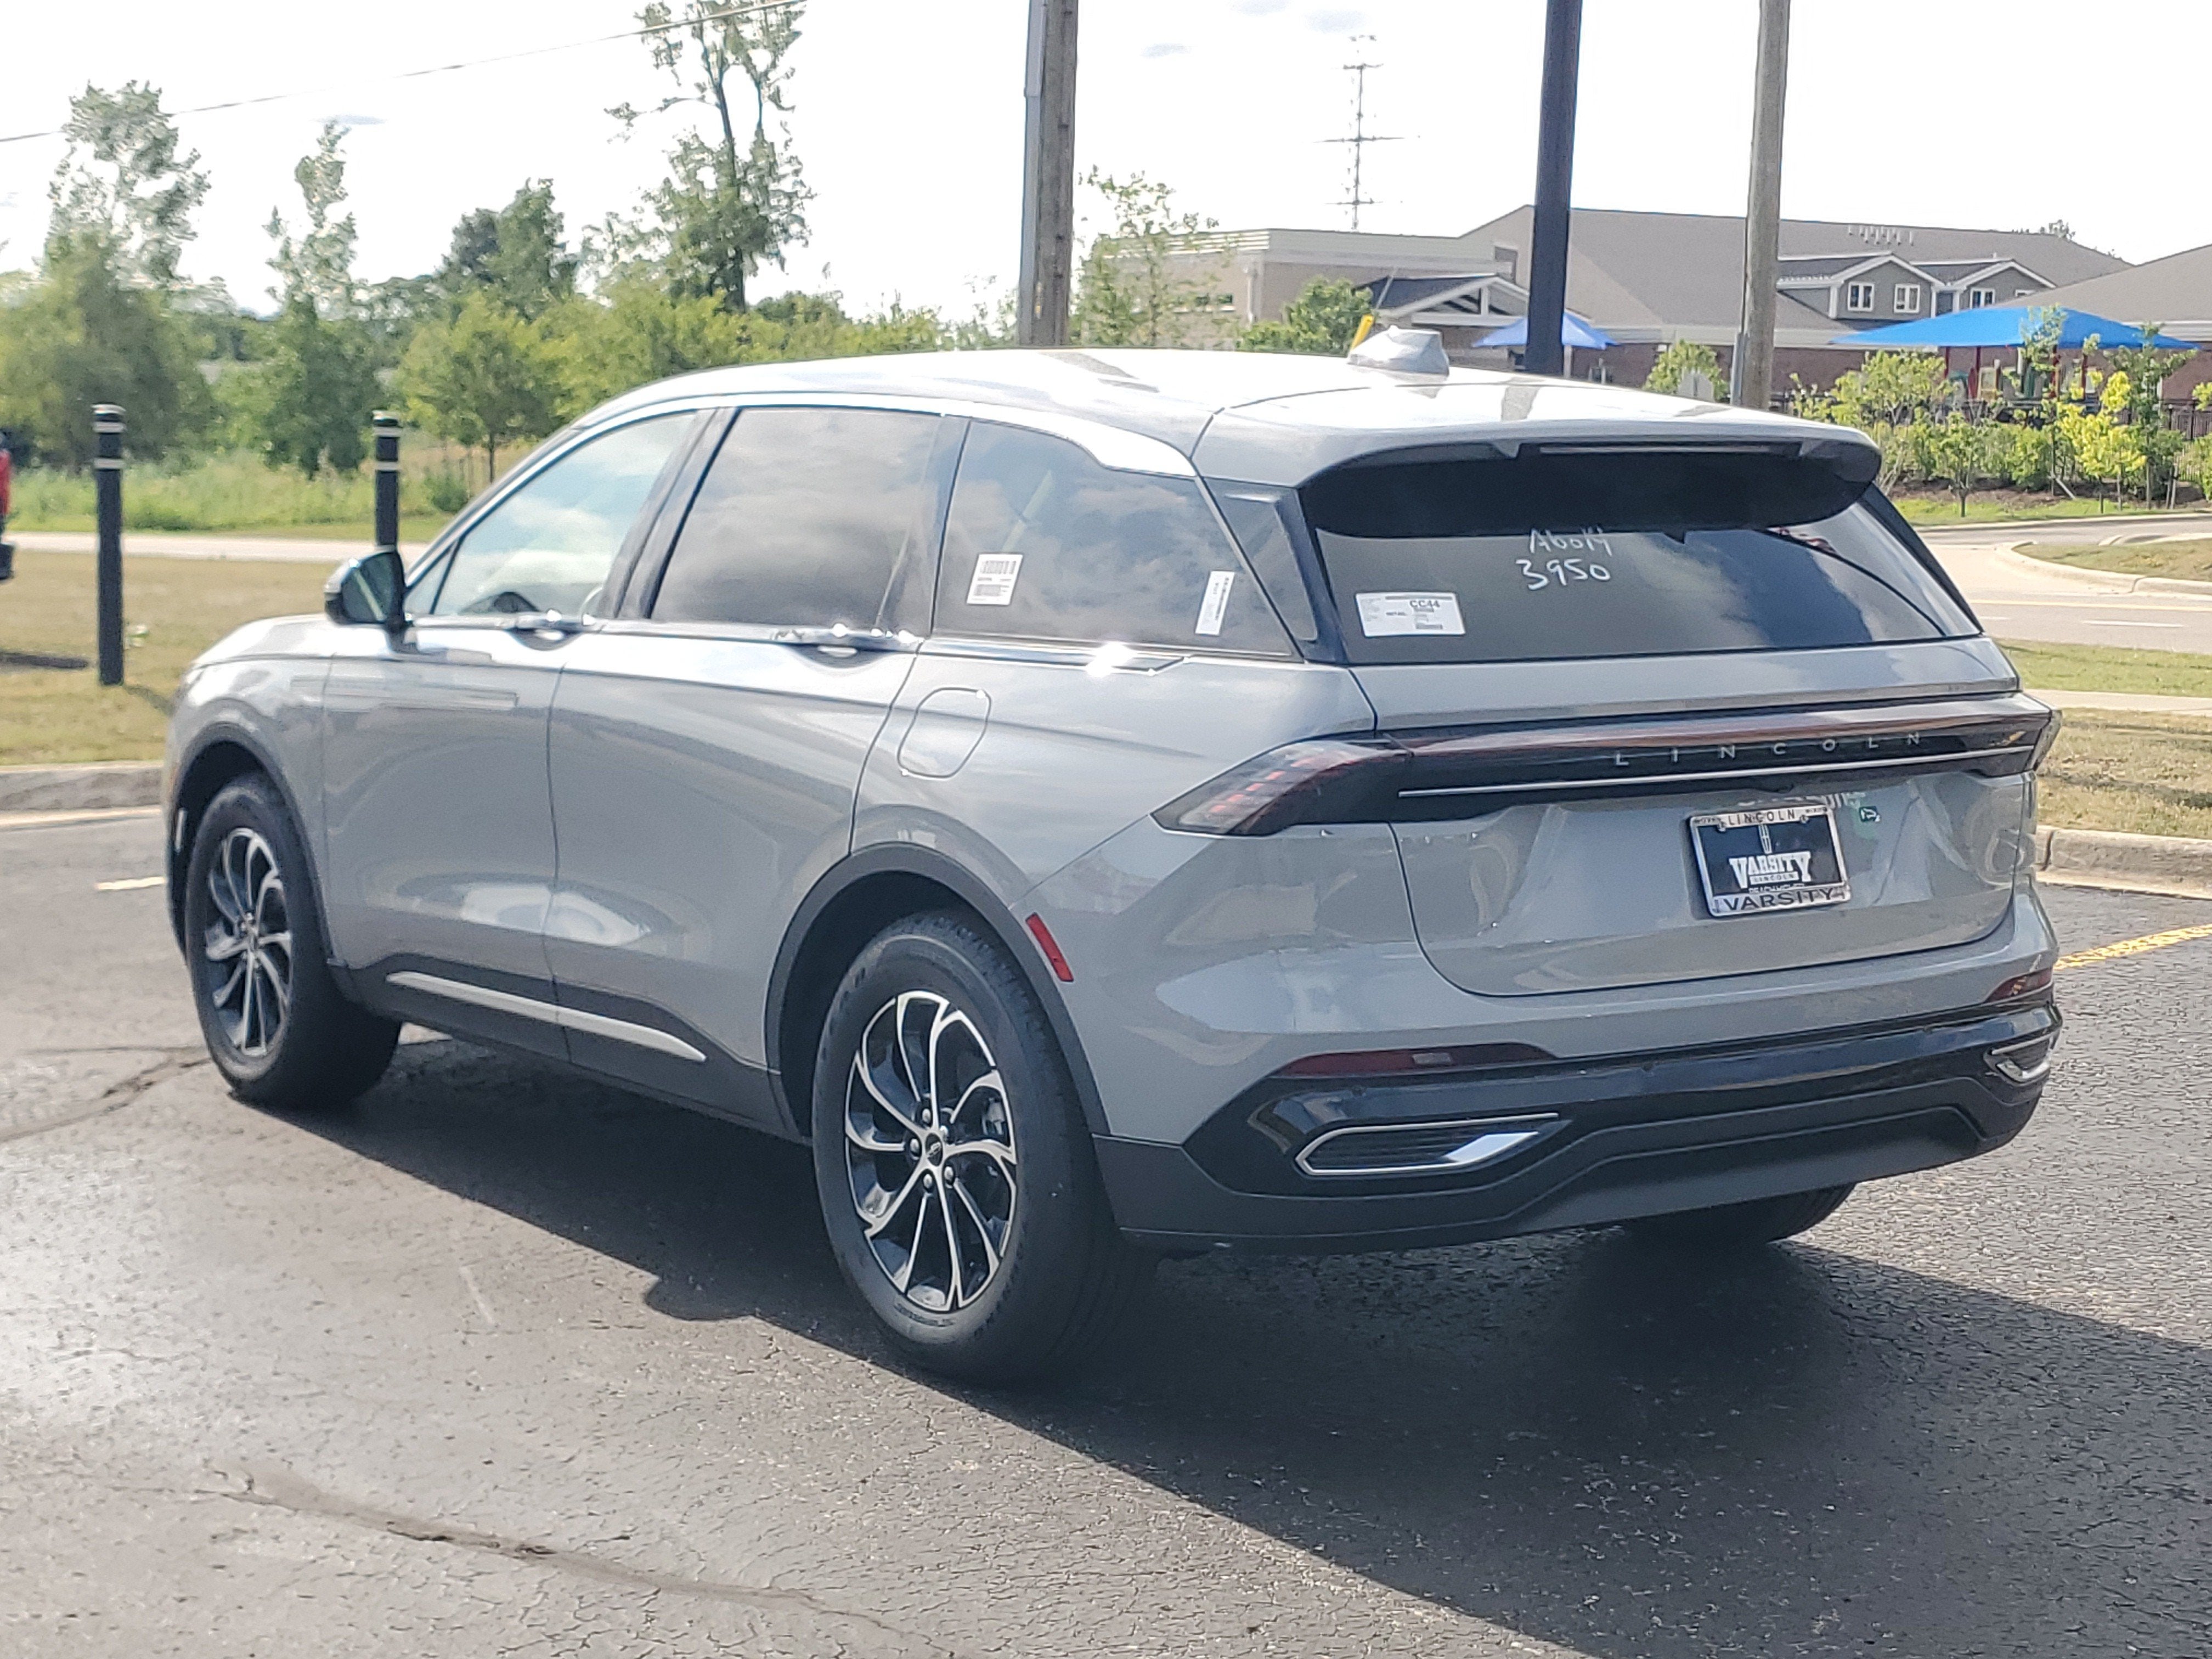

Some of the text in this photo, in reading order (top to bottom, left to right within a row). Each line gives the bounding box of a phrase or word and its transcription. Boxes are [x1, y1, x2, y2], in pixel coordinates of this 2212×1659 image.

[1515, 558, 1611, 590] 3950
[1409, 600, 1441, 608] CC44
[1616, 732, 1920, 766] LINCOLN
[1728, 809, 1796, 826] LINCOLN
[1729, 851, 1811, 889] VARSITY
[1723, 887, 1833, 911] VARSITY
